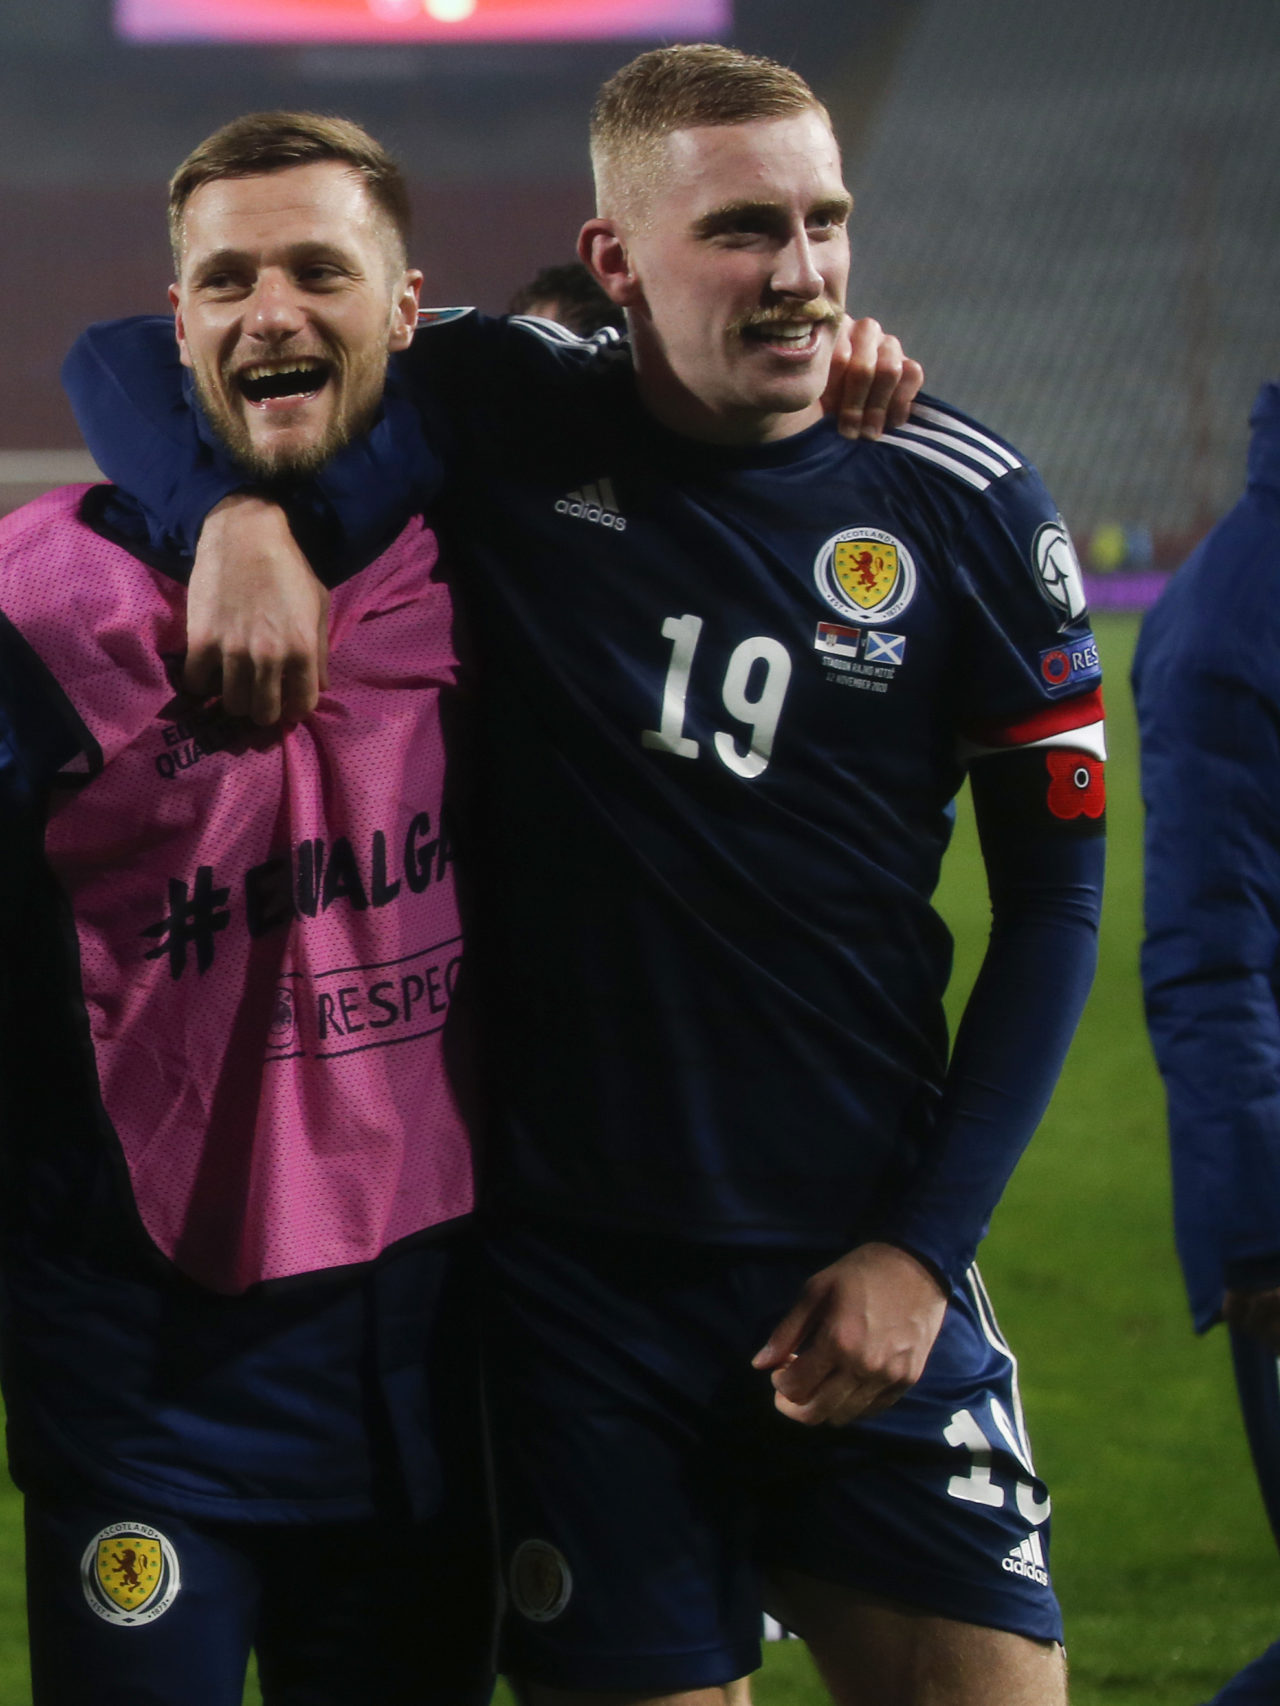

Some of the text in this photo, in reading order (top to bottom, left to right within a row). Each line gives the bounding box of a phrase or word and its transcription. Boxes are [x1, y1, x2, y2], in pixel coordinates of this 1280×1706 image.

[554, 500, 627, 531] adidas
[839, 529, 892, 544] SCOTLAND
[1071, 644, 1100, 671] RES
[641, 613, 793, 780] 19
[103, 1523, 155, 1537] SCOTLAND
[1001, 1556, 1049, 1587] adidas
[93, 1600, 106, 1616] EST
[150, 1600, 169, 1617] 1873
